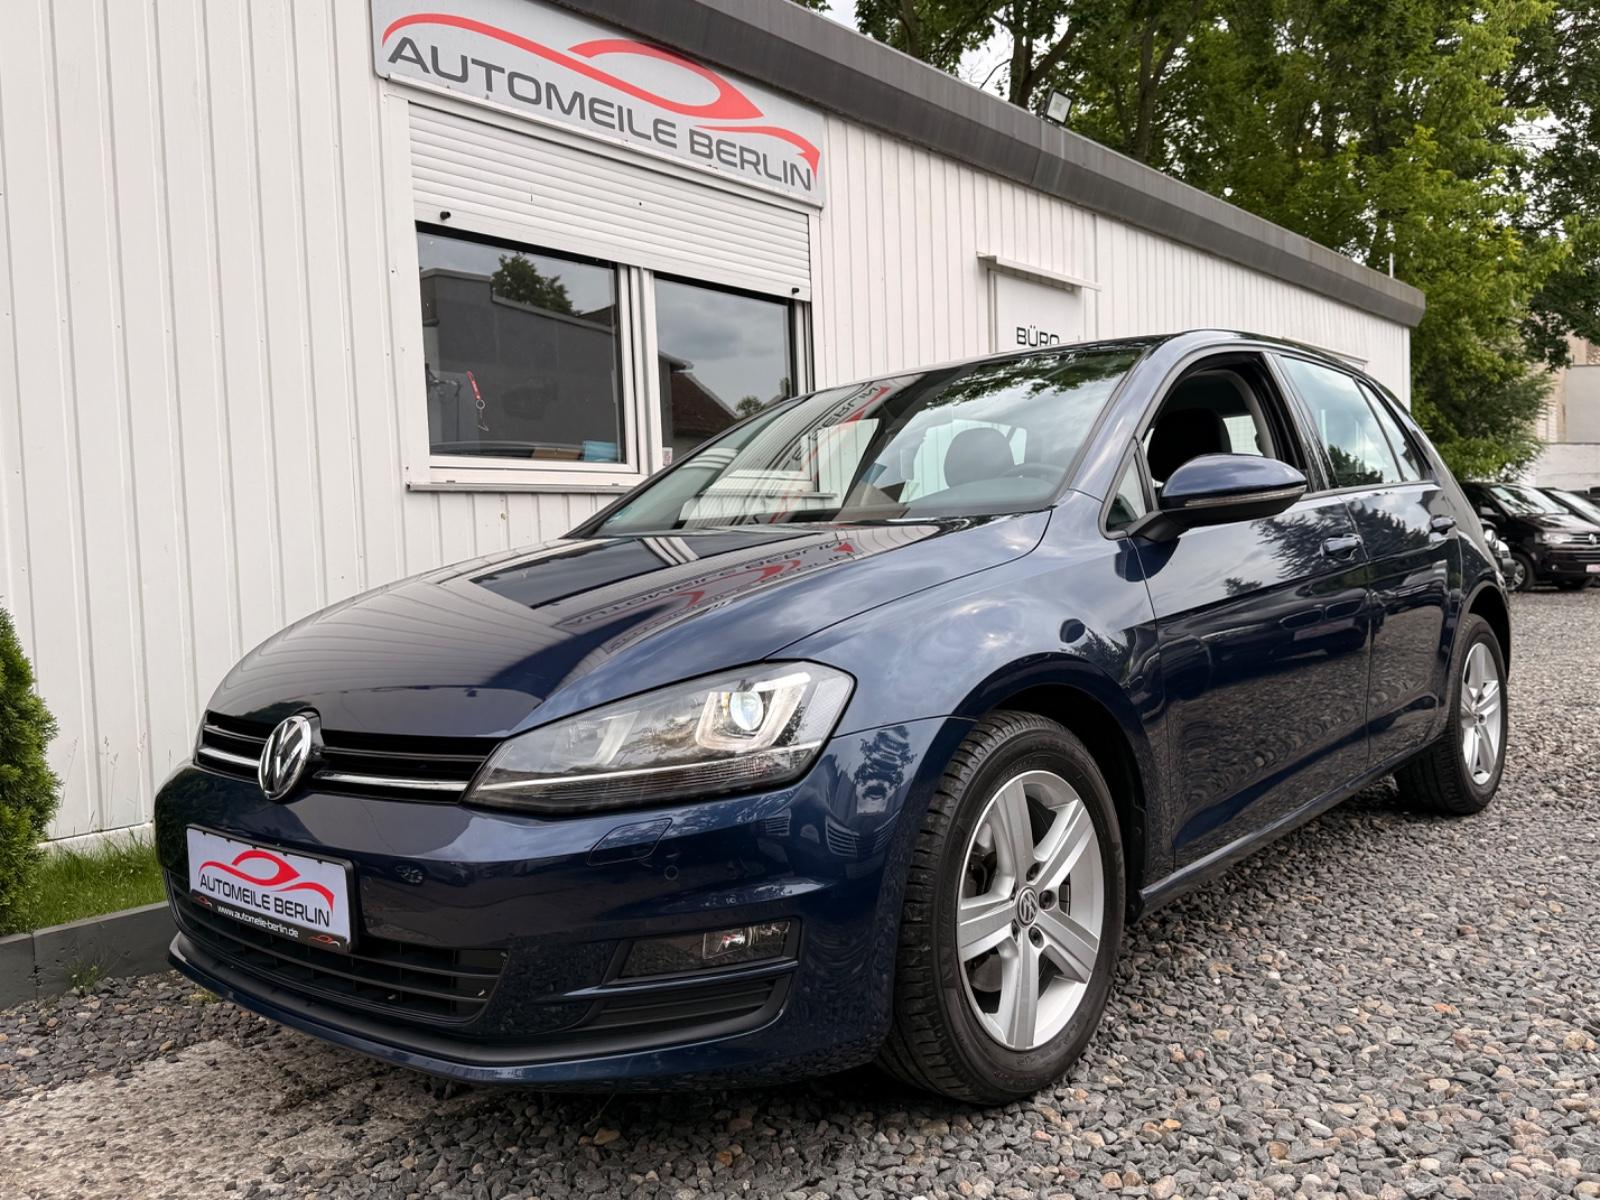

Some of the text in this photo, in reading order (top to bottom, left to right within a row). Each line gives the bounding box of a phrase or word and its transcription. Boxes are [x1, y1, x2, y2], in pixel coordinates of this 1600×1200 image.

[388, 37, 811, 191] AUTOMEILE BERLIN
[200, 874, 330, 927] AUTOMEILE BERLIN
[217, 905, 299, 938] www.automeile-berlin.de
